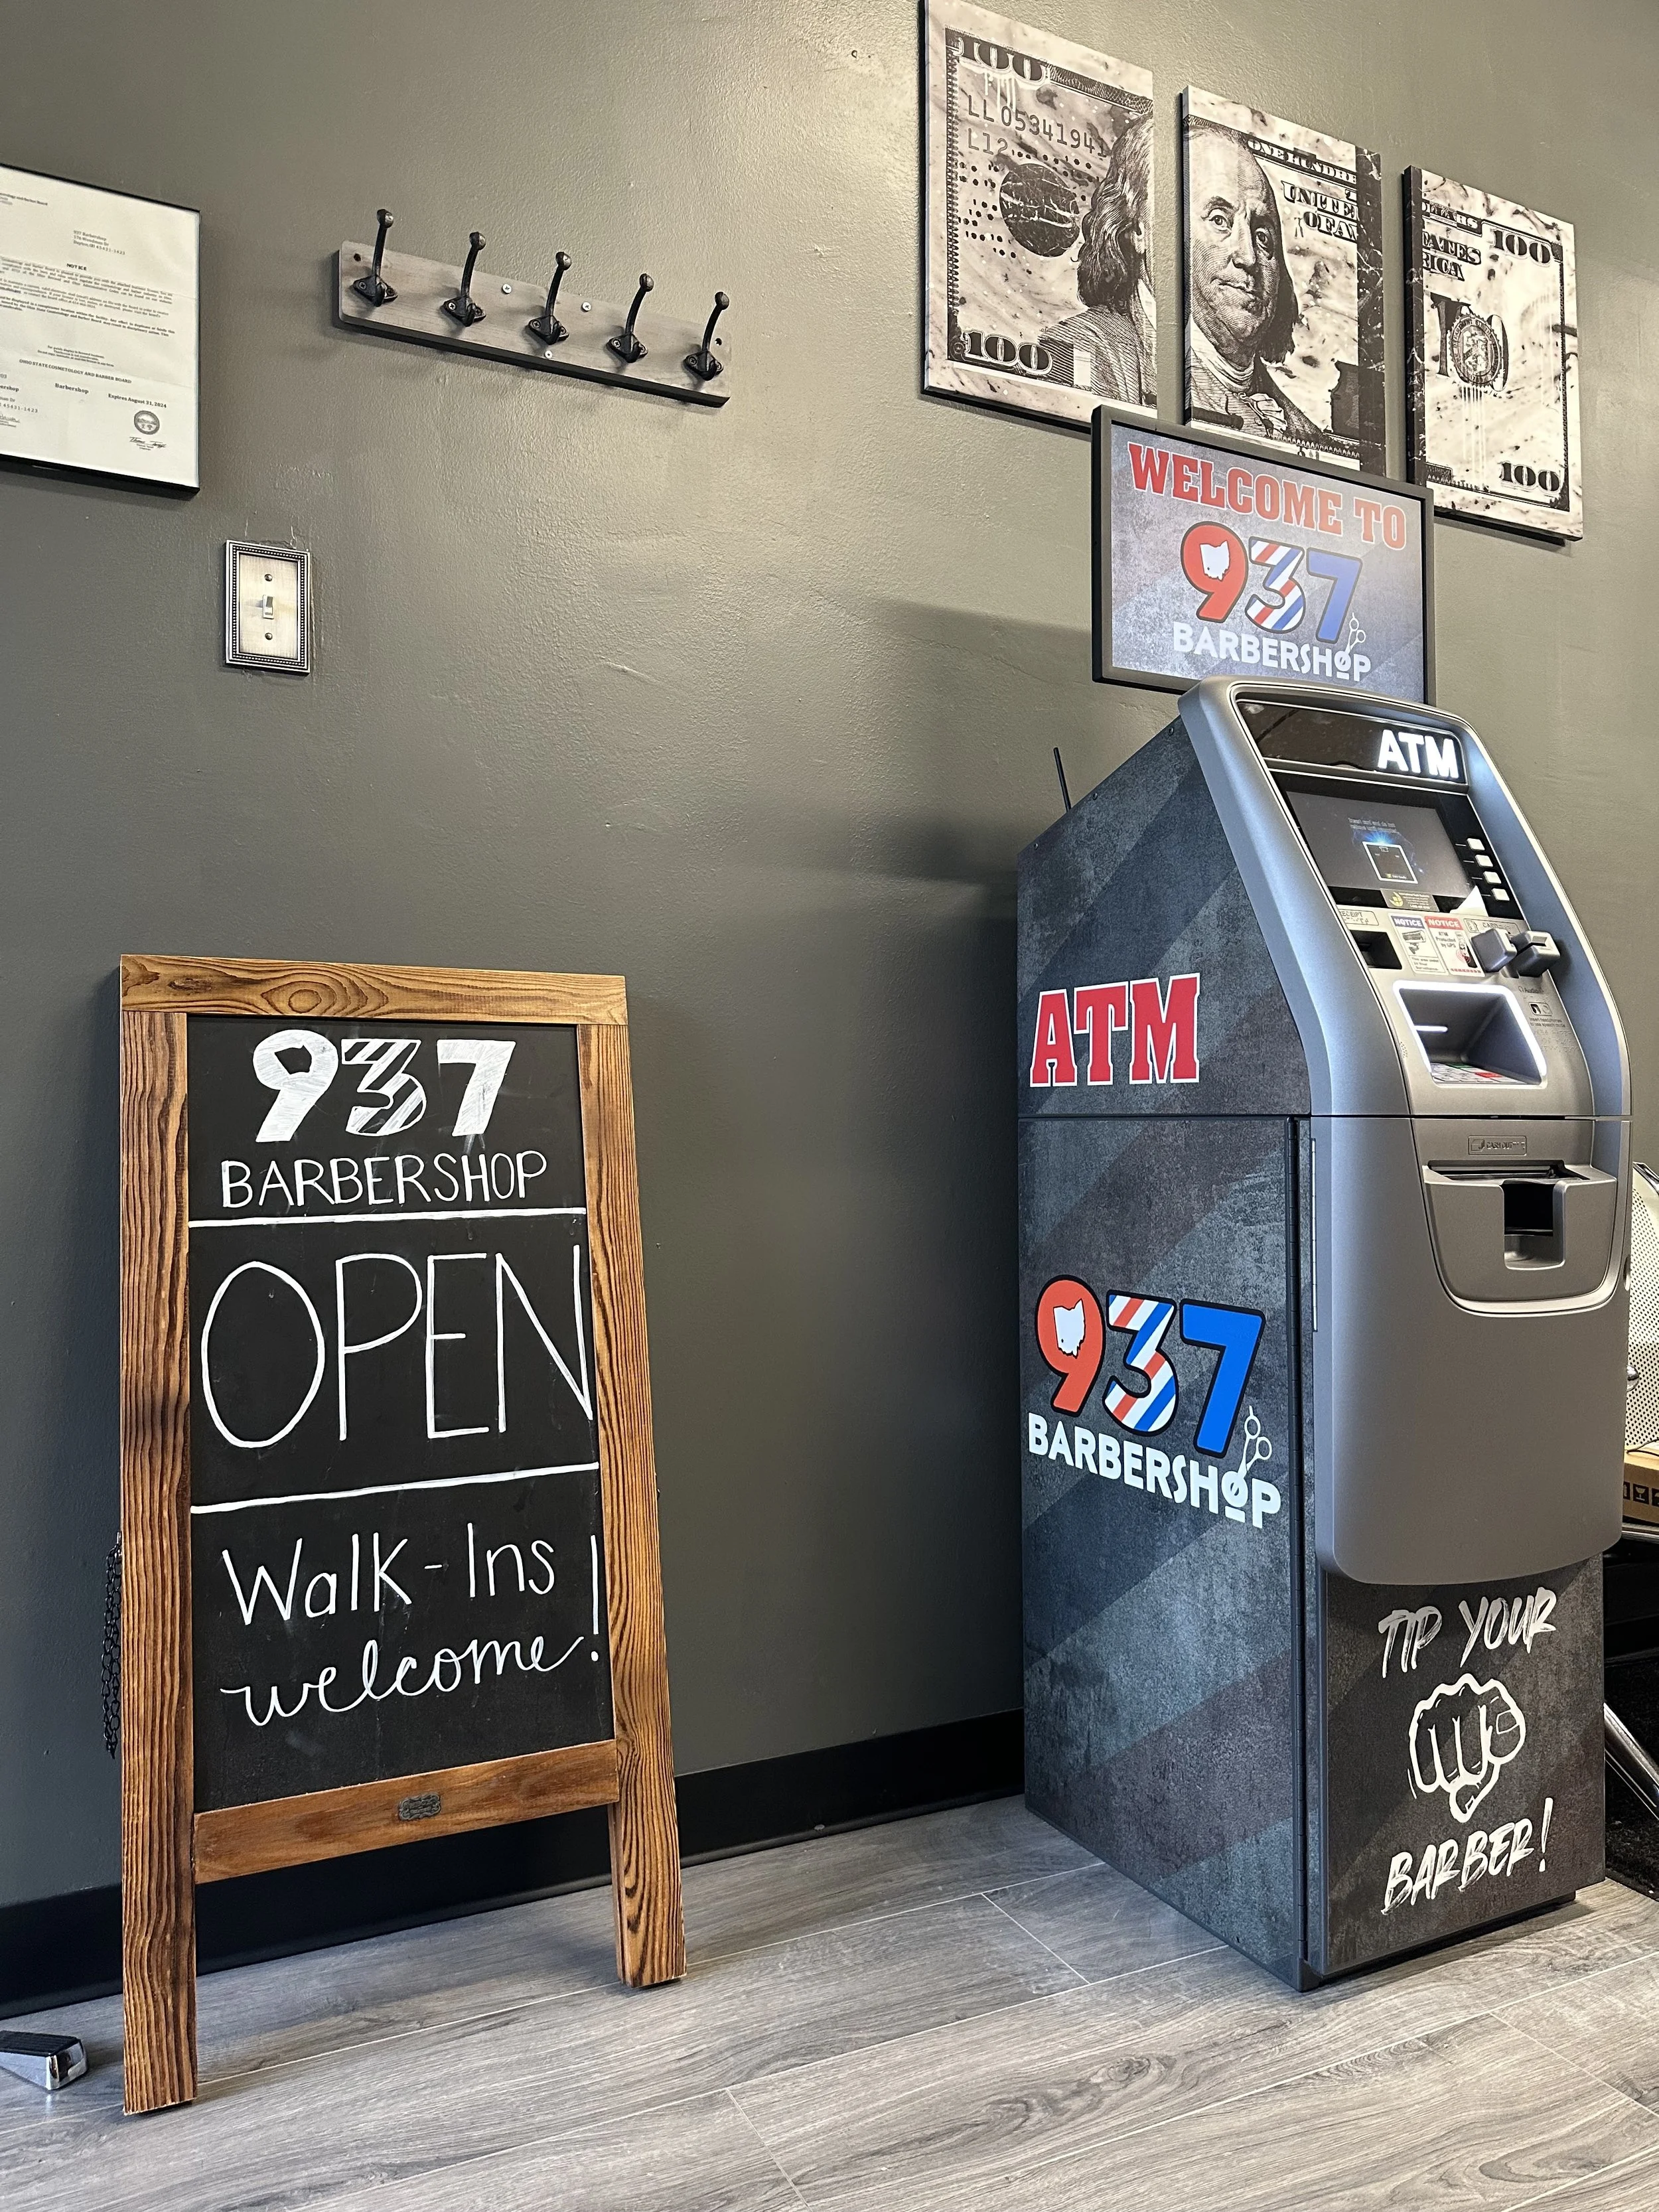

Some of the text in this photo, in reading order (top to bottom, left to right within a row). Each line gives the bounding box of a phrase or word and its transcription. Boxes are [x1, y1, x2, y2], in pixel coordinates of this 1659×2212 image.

[968, 128, 1008, 155] L12
[1248, 139, 1285, 160] ONE
[1492, 229, 1552, 266] 100
[48, 364, 84, 375] COSMETOLOGY
[962, 329, 1052, 375] 100
[0, 384, 19, 393] ershop
[55, 382, 89, 394] Barbershop
[108, 393, 127, 402] Expires
[128, 396, 145, 405] August
[1128, 441, 1407, 551] WELCOME TO
[1499, 461, 1560, 493] 100
[1180, 521, 1363, 644] 937
[1173, 621, 1372, 682] BARBERSHOP
[1377, 729, 1459, 779] ATM
[1030, 972, 1200, 1088] ATM
[253, 1029, 516, 1143] 937
[221, 1149, 548, 1209] BARBERSHOP
[201, 1244, 593, 1449] OPEN
[1035, 1274, 1265, 1459] 937
[1029, 1412, 1281, 1529] BARBERSHOP
[1378, 1586, 1557, 1678] TIP YOUR
[1380, 1797, 1554, 1915] BARBER!
